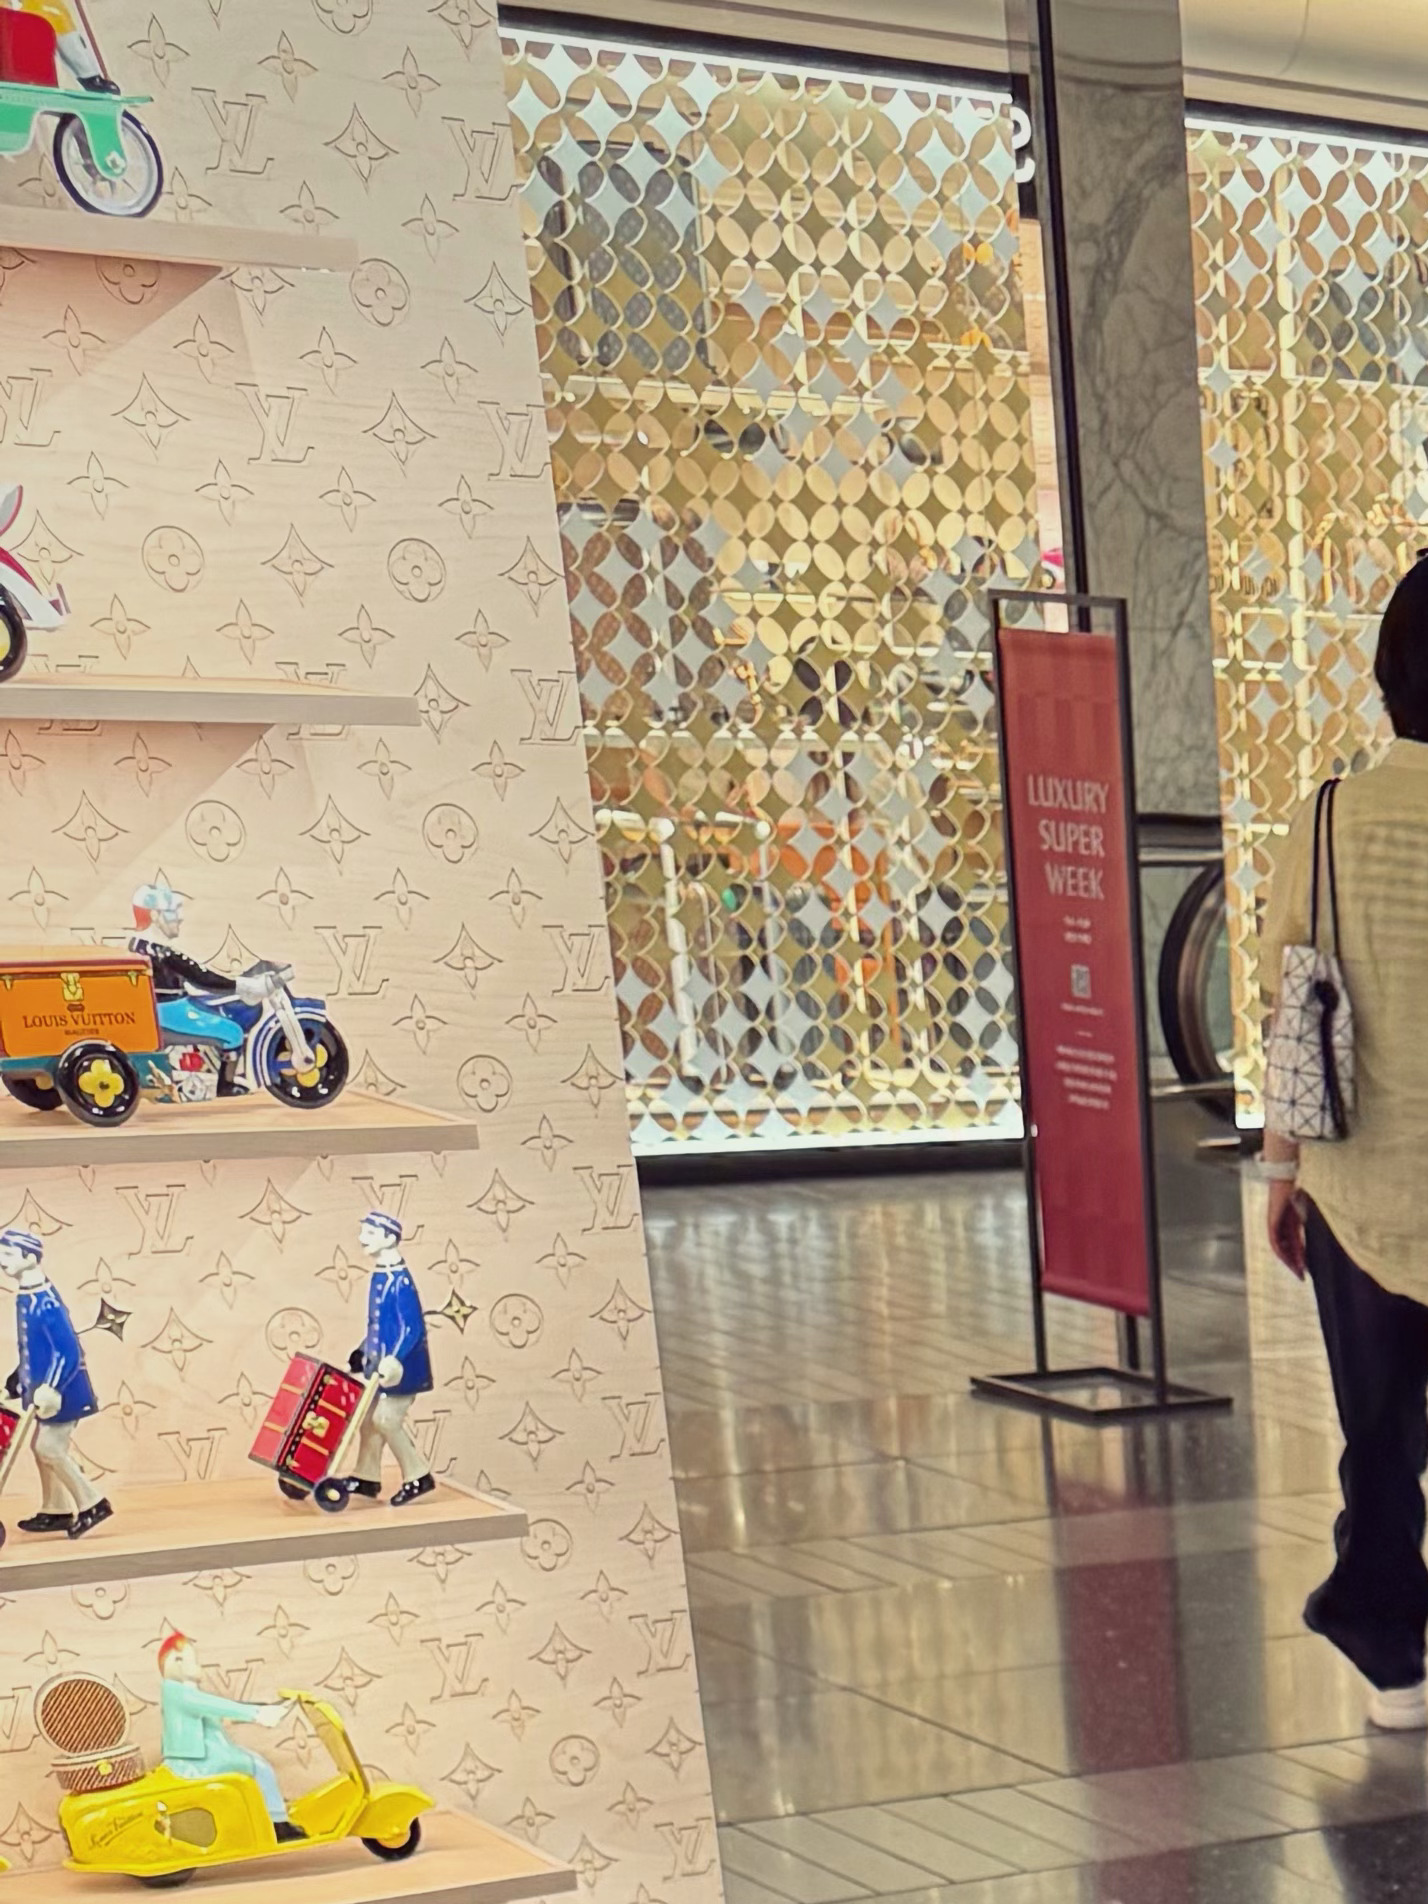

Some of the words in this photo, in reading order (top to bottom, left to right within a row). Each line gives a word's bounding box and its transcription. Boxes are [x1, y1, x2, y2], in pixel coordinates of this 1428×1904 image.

[1027, 774, 1109, 814] LUXURY
[1038, 818, 1105, 857] SUPER
[1044, 862, 1105, 900] WEEK
[22, 1014, 68, 1029] LOUIS
[70, 1012, 136, 1027] VUITTON
